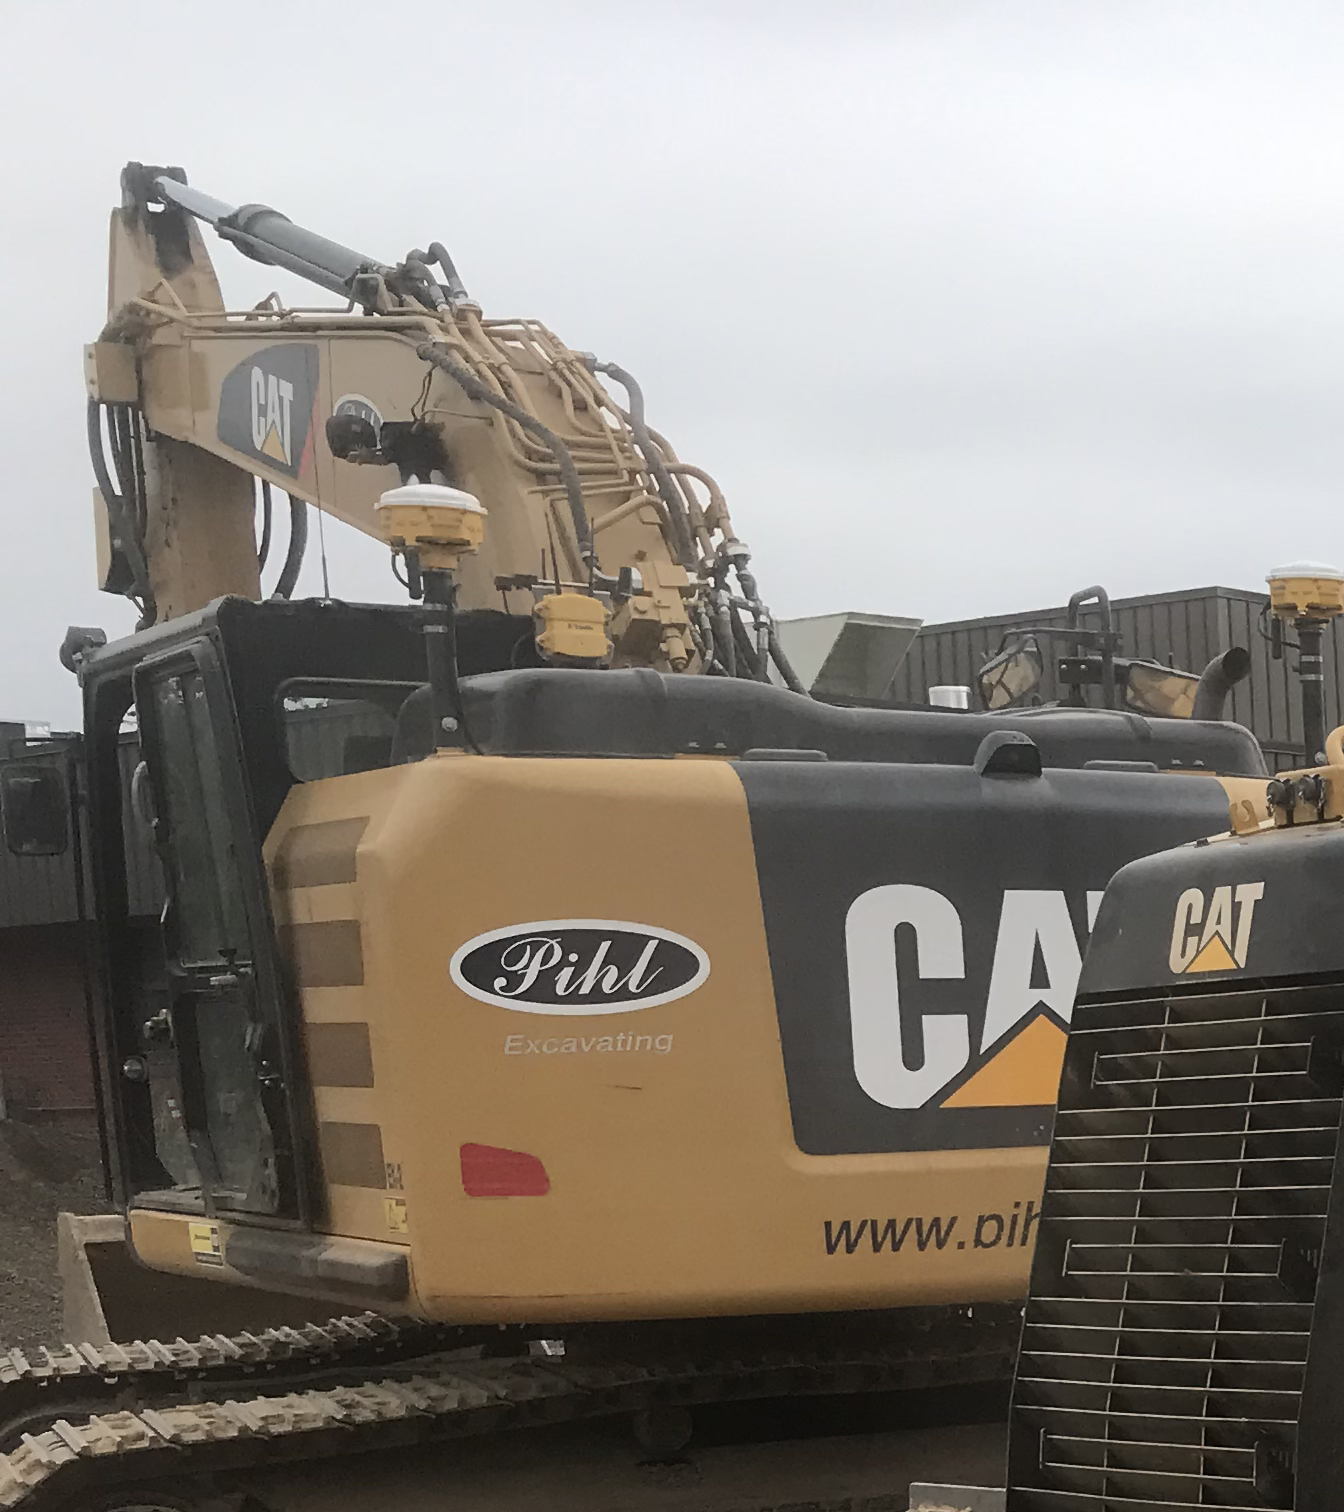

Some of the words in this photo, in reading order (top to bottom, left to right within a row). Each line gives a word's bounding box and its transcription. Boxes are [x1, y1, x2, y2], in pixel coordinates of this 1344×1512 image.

[251, 366, 293, 467] CAT
[493, 937, 664, 996] Pihl
[1168, 881, 1265, 974] CAT
[845, 883, 1105, 1109] CA
[504, 1032, 673, 1055] Excavating
